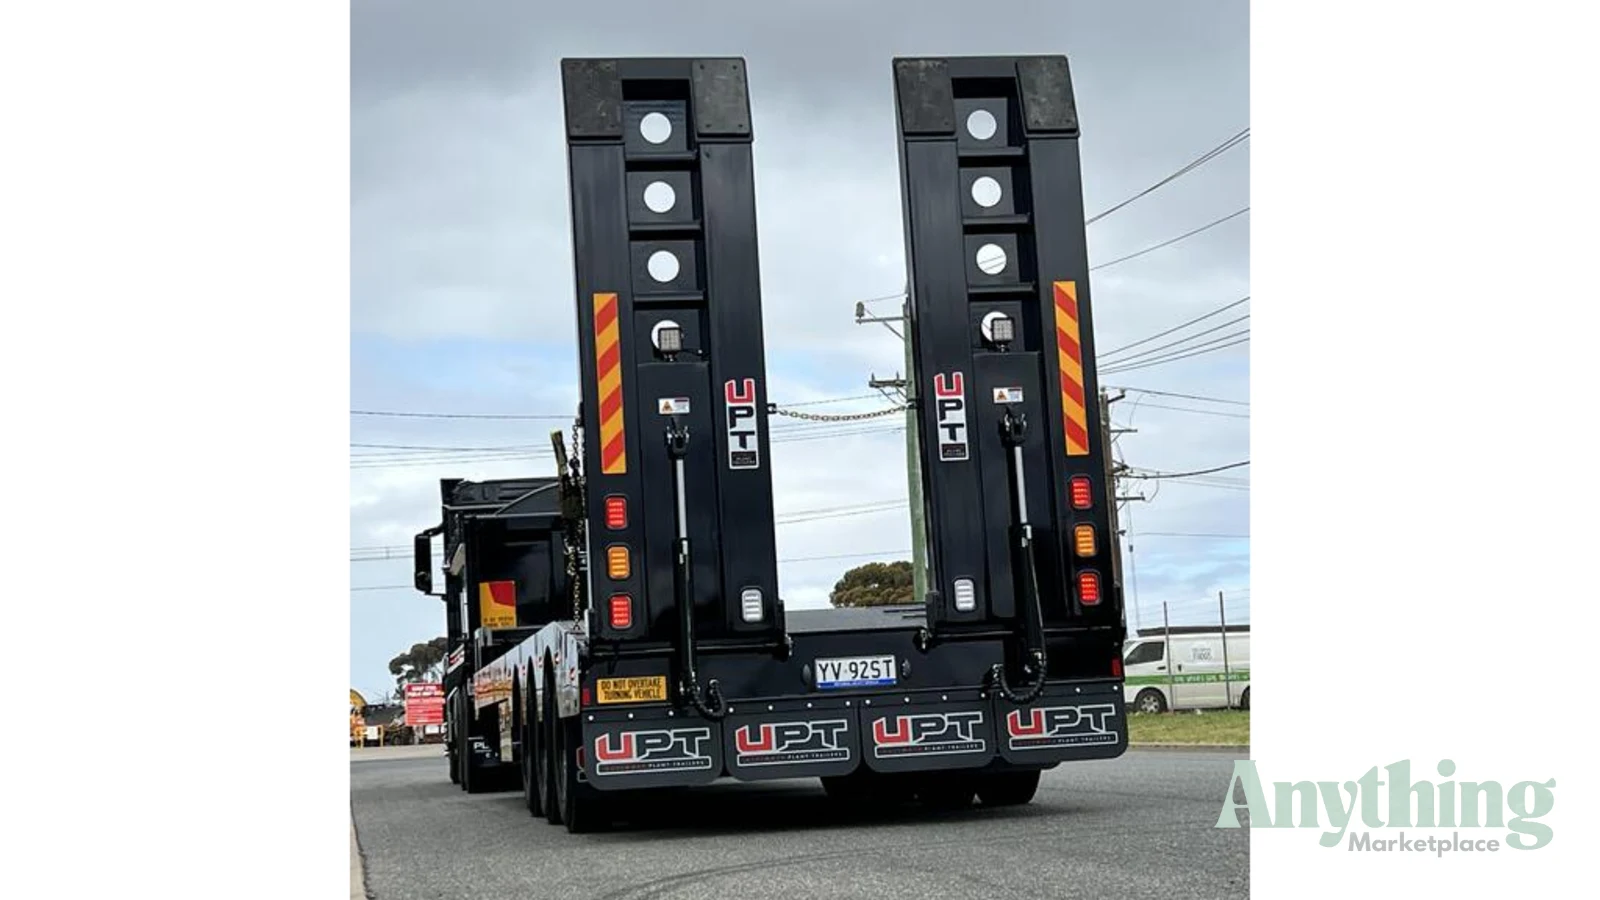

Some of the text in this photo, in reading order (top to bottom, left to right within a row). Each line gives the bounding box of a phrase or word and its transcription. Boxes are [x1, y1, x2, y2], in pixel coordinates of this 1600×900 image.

[725, 378, 756, 450] UPT
[934, 372, 965, 442] UPT
[601, 677, 661, 690] DO NOT OVERTAKE
[818, 659, 893, 681] YV 92ST
[604, 688, 661, 700] TURNING VEHICLE
[735, 719, 848, 754] UPT
[873, 711, 983, 746] UPT
[1006, 703, 1116, 738] UPT
[595, 727, 710, 762] UPT
